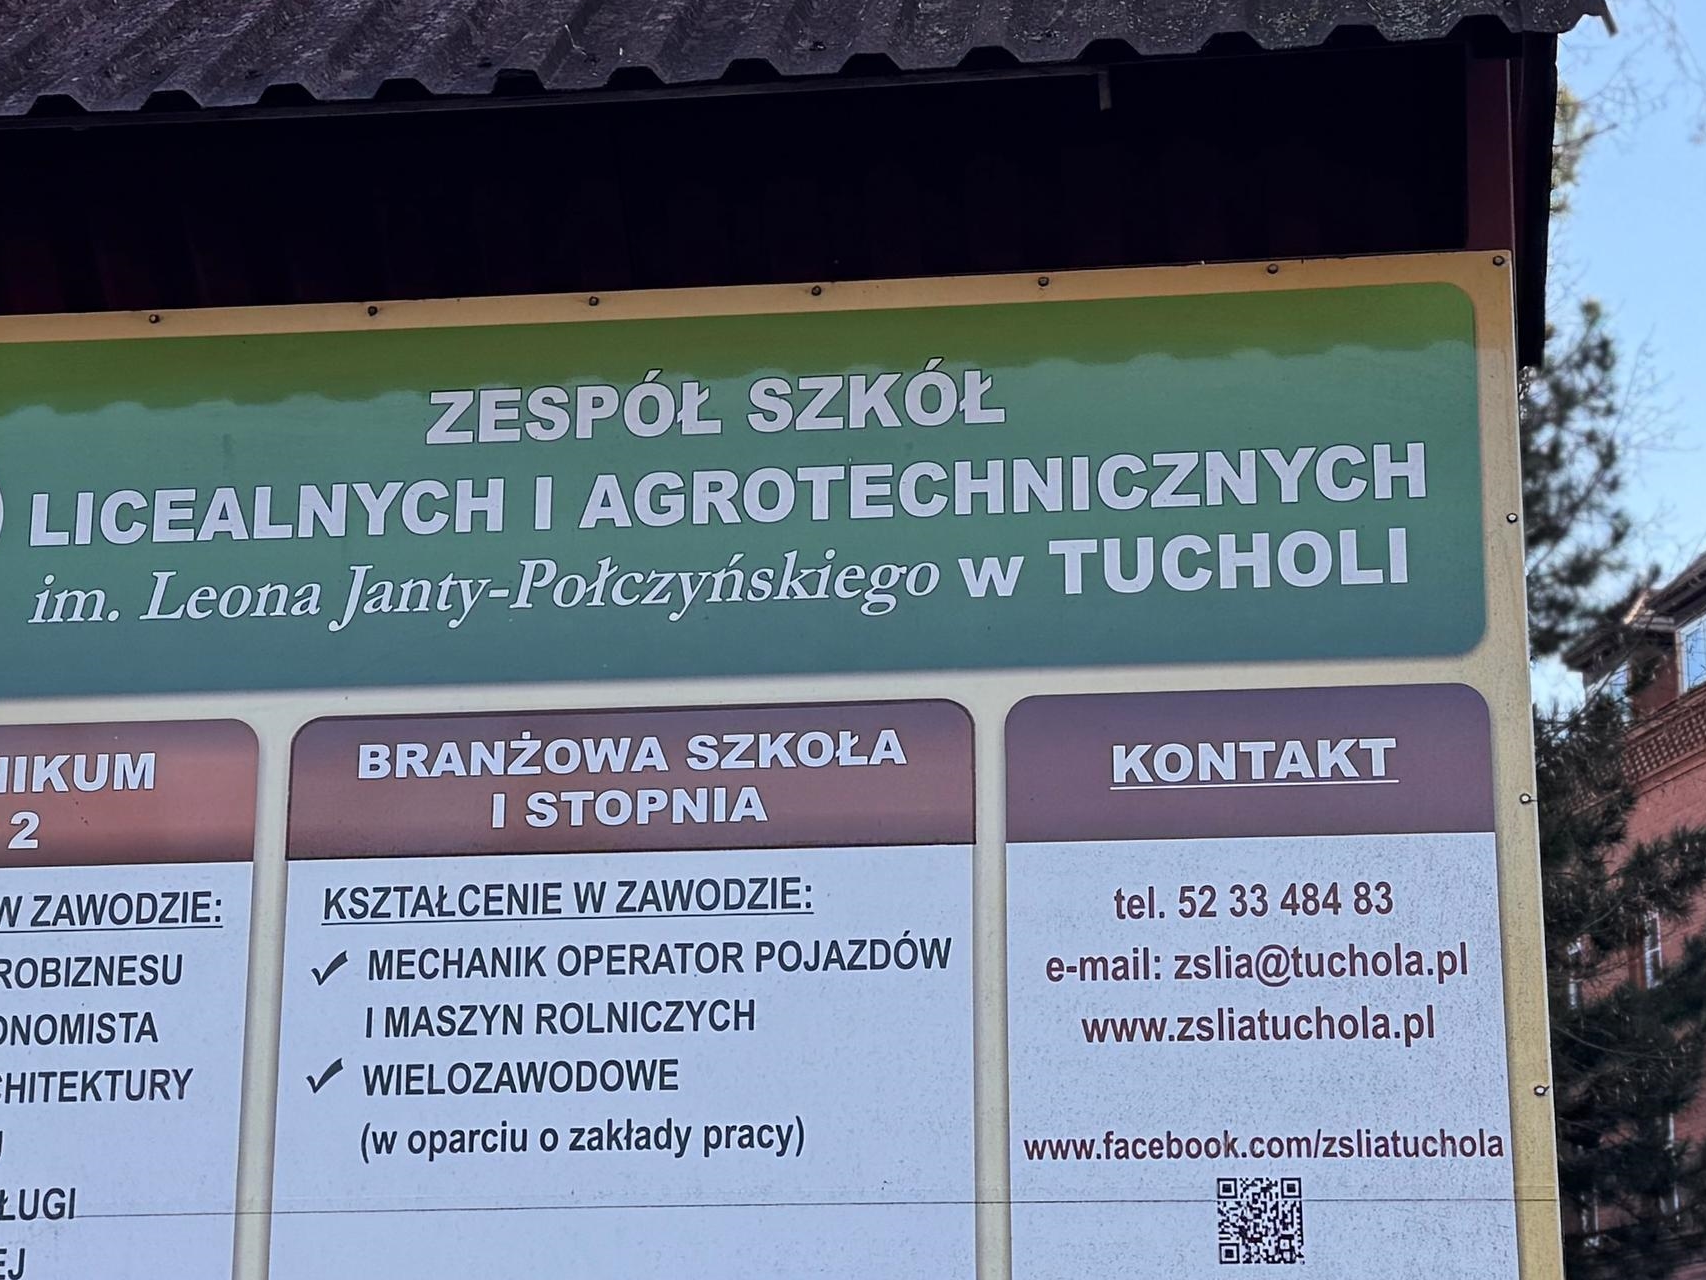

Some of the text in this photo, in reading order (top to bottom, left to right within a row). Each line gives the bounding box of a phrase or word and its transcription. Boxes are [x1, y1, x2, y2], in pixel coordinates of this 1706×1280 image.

[427, 359, 1005, 444] ZESPÓŁ SZKÓŁ
[30, 443, 1426, 546] LICEALNYCH I AGROTECHNICZNYCH
[28, 528, 1407, 631] im. Leona Janty-Połczyńskiego w TUCHOLI
[359, 730, 907, 778] BRANŻOWA SZKOŁA
[1113, 738, 1399, 785] KONTAKT
[493, 787, 767, 827] I STOPNIA
[8, 812, 39, 848] 2
[31, 891, 221, 927] ZAWODZIE:
[322, 877, 811, 922] KSZTAŁCENIE W ZAWODZIE:
[1114, 882, 1393, 919] tel. 52 33 484 83
[369, 930, 951, 980] MECHANIK OPERATOR POJAZDÓW
[1046, 942, 1467, 987] e-mail: zslia@tuchola.pl
[366, 999, 754, 1038] I MASZYN ROLNICZYCH
[1082, 1005, 1434, 1047] www.zsliatuchola.pl
[363, 1059, 678, 1096] WIELOZAWODOWE
[361, 1116, 804, 1164] (w oparciu o zakłady pracy)
[1024, 1128, 1503, 1160] www.facebook.com/zsliatuchola
